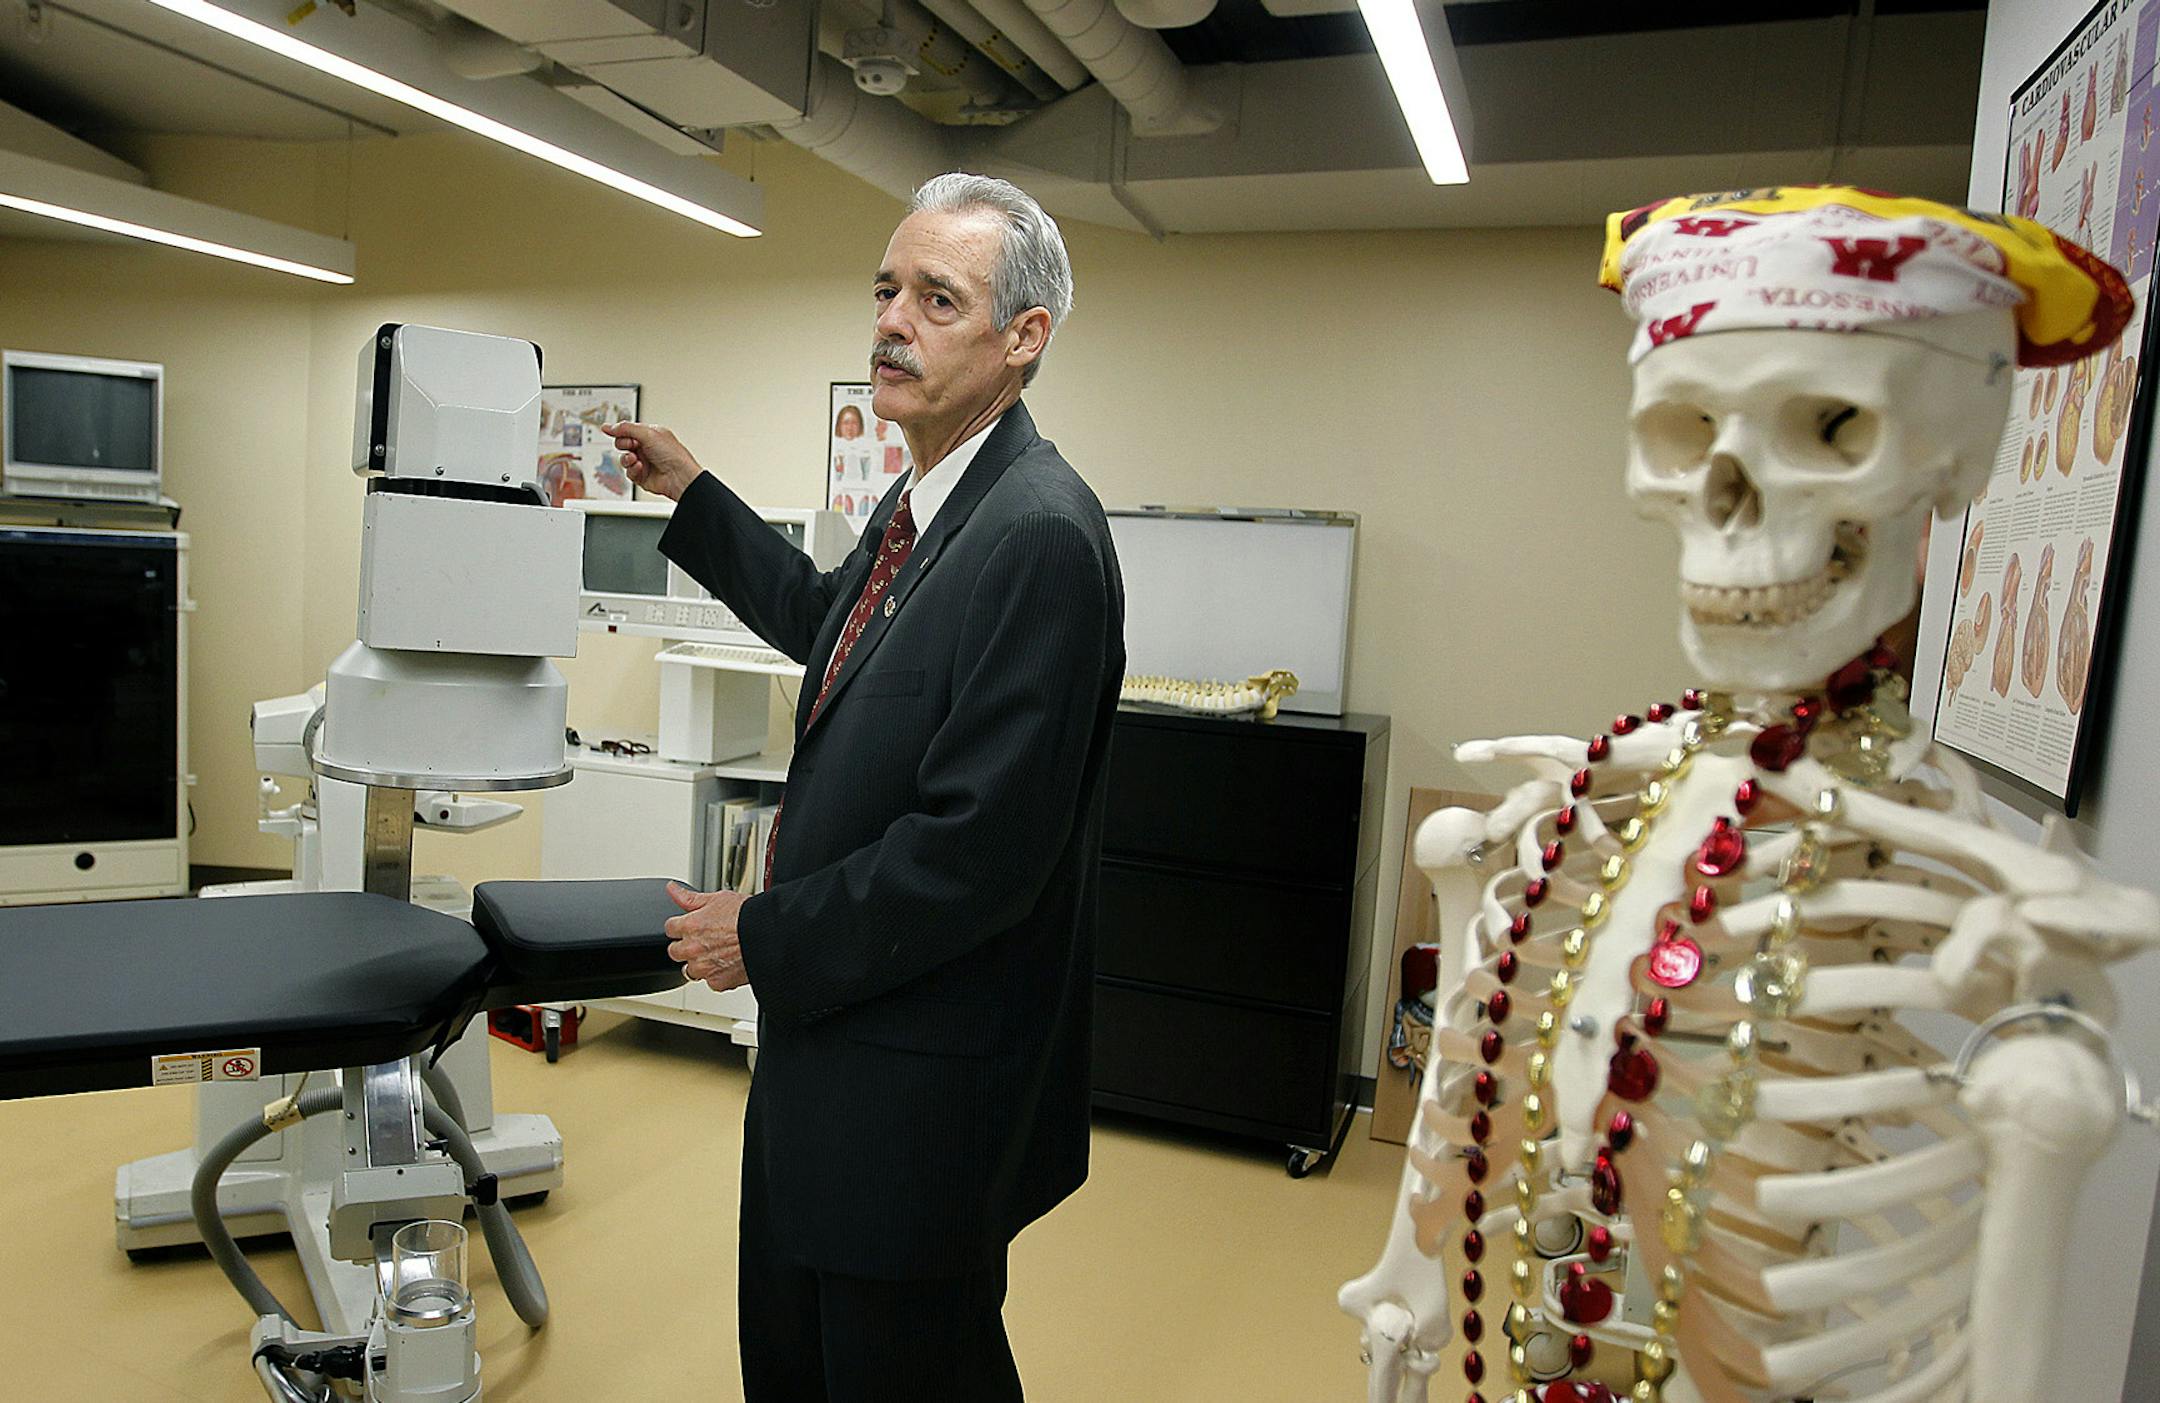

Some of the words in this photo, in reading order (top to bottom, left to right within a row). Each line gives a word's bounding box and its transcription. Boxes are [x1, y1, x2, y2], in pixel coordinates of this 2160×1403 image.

[2021, 2, 2118, 116] CARDIOVASCULAR
[1819, 236, 1927, 282] M
[847, 387, 865, 395] THE
